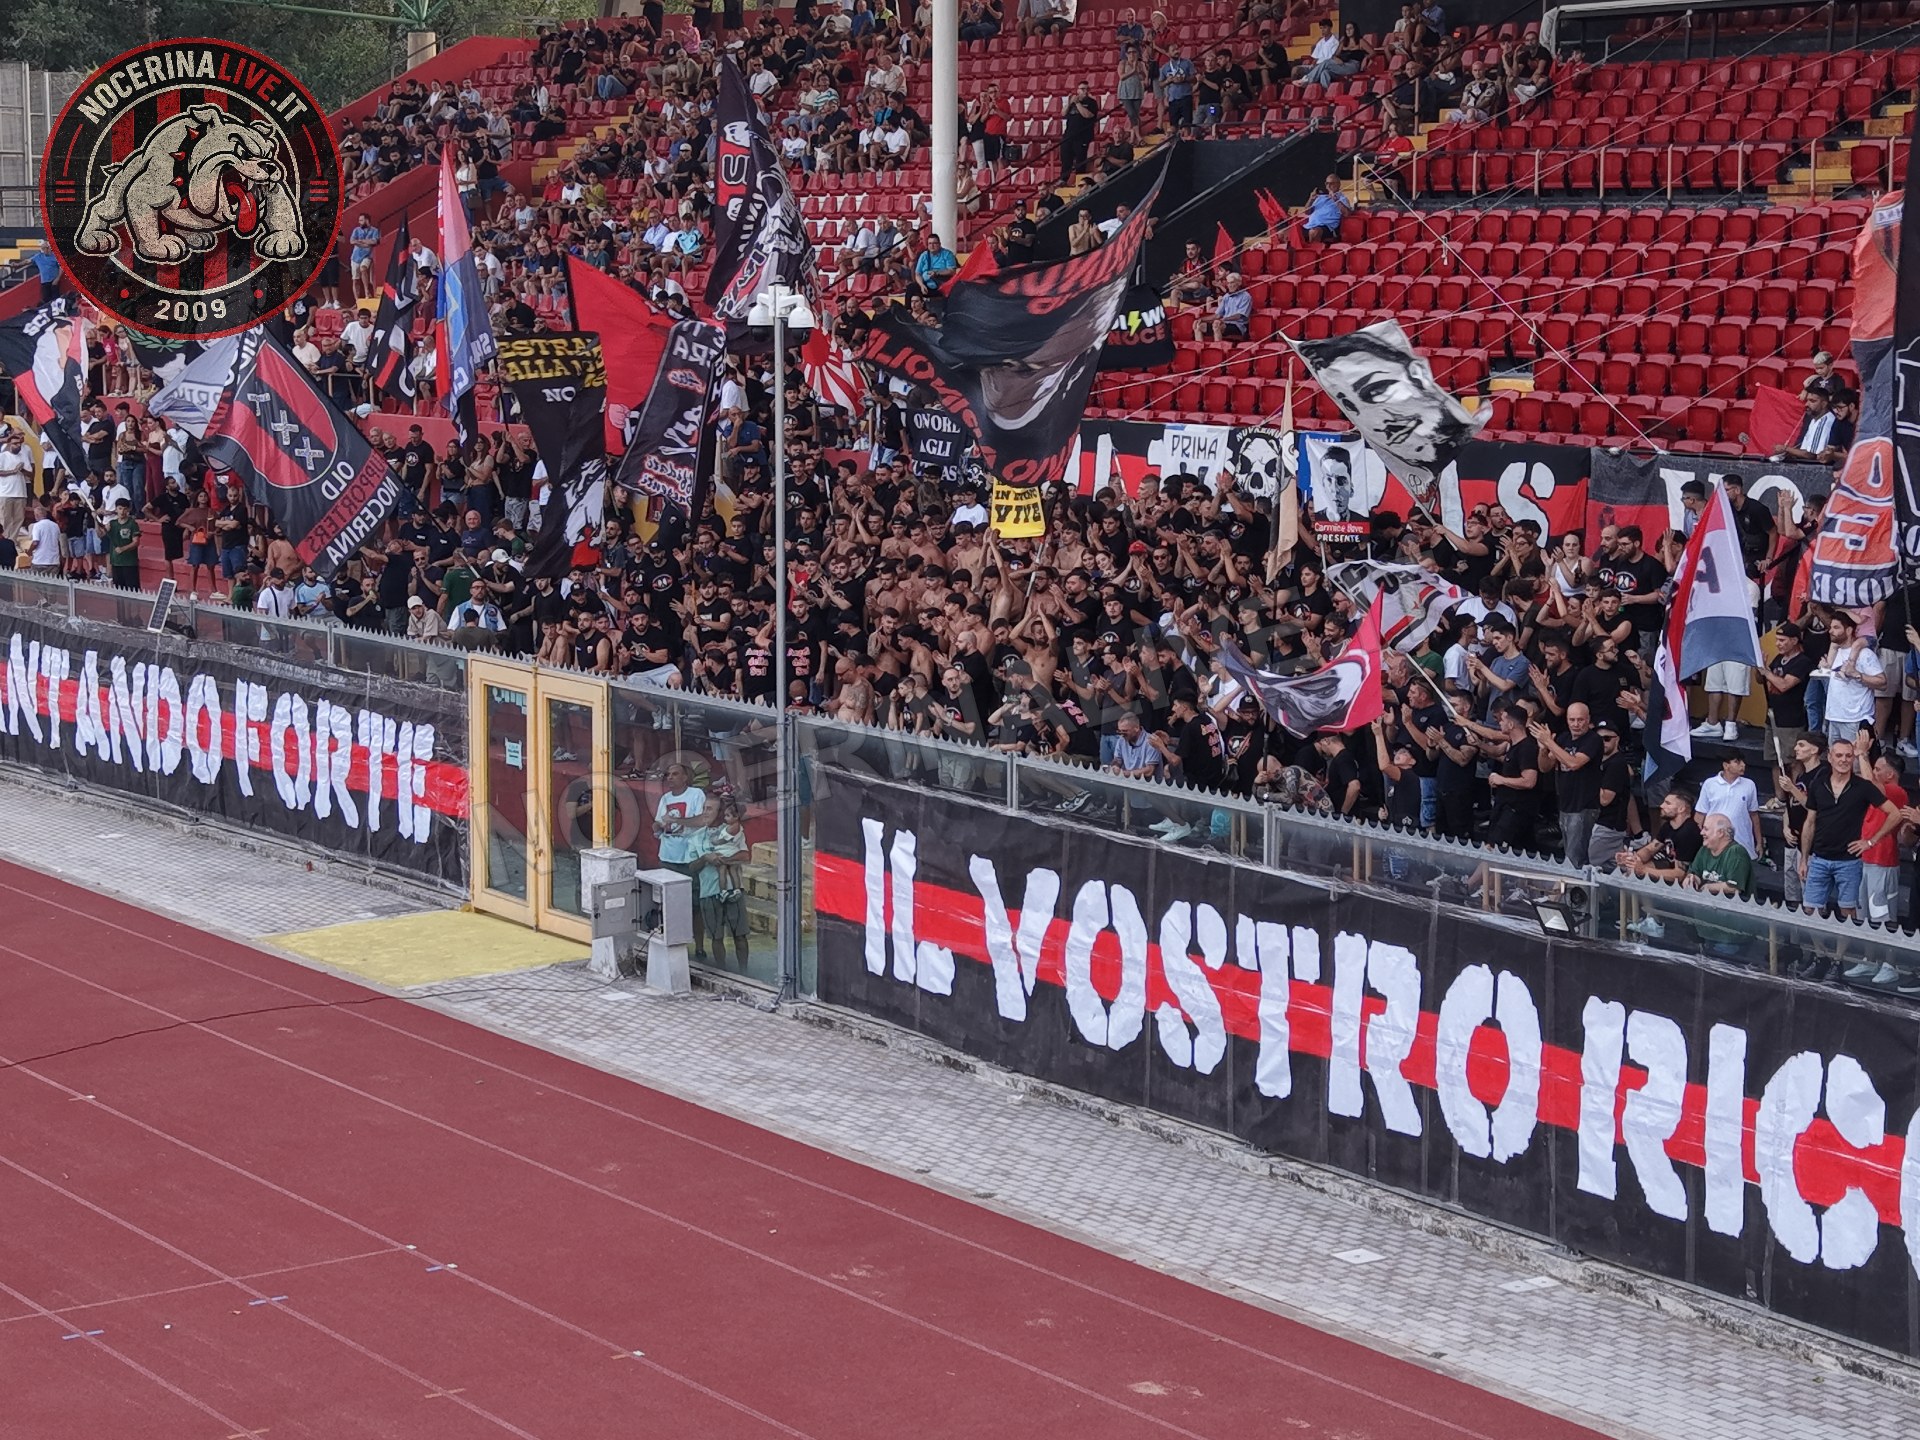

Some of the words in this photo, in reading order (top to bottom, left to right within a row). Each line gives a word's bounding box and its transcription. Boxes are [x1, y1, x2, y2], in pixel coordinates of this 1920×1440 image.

[506, 358, 571, 381] ALLA
[1171, 435, 1218, 460] PRIMA
[995, 490, 1011, 500] IN
[995, 502, 1041, 524] VIVE
[1317, 533, 1361, 543] PRESENTE
[0, 633, 222, 784] NTANDO
[235, 677, 435, 844] FORTE
[862, 817, 956, 996] IL
[969, 854, 1542, 1163] VOSTRO
[1576, 995, 1920, 1284] RIC
